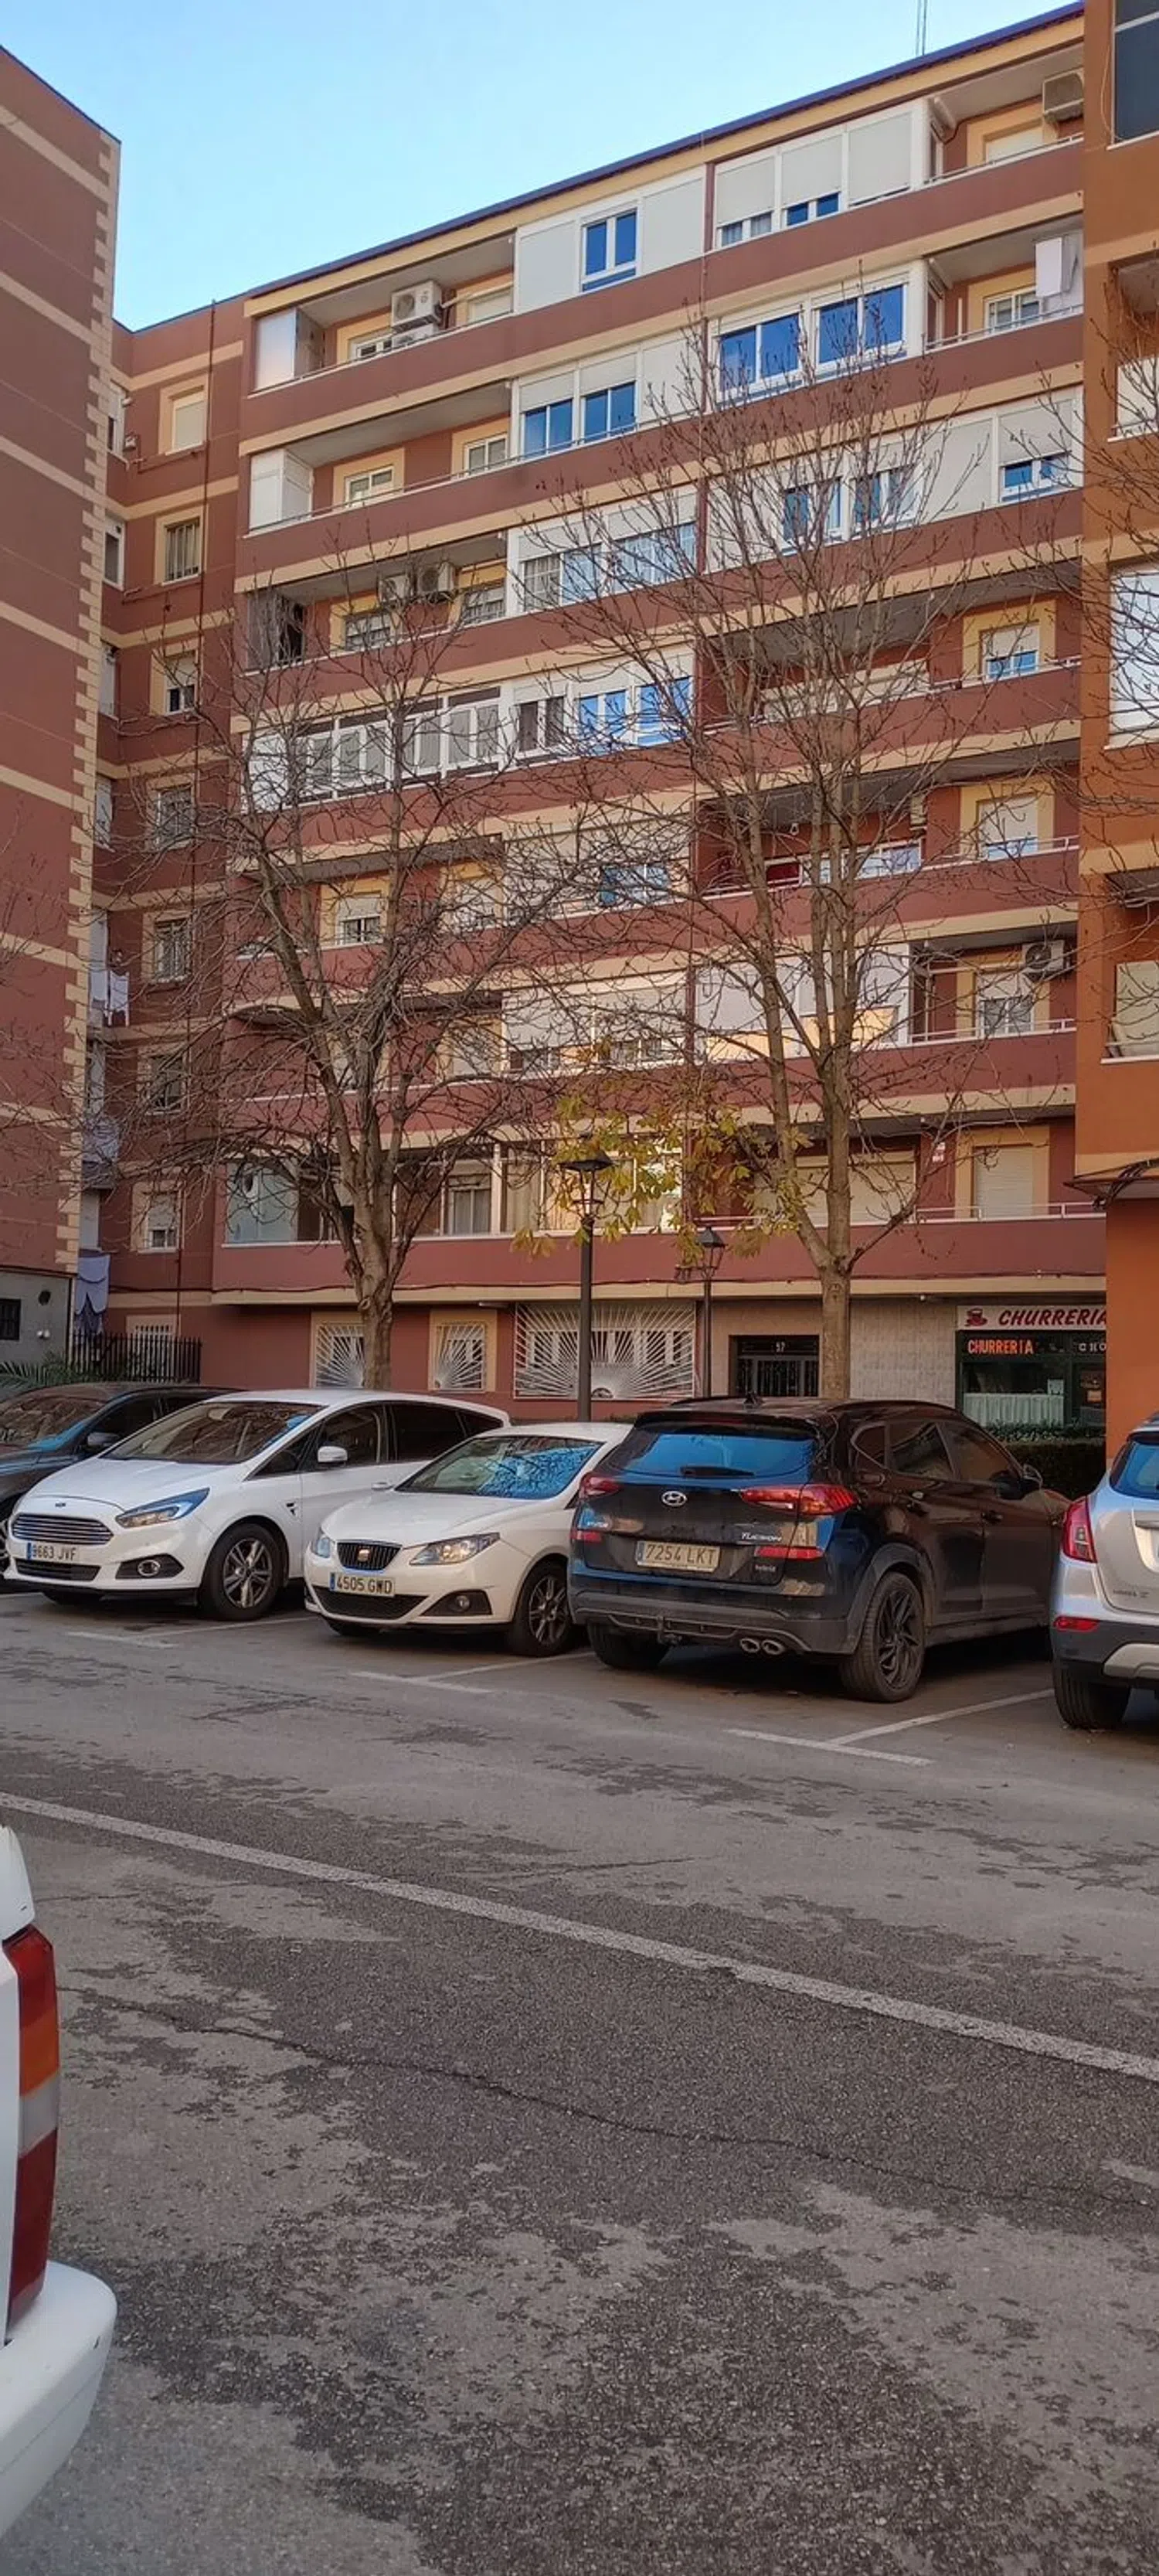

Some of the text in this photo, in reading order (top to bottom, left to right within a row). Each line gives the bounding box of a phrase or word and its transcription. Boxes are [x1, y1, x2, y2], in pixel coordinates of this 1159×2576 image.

[998, 1308, 1106, 1326] CHURRERIA
[967, 1339, 1035, 1354] CHURRERIA
[646, 1545, 716, 1565] 7254 LKT
[336, 1574, 393, 1594] 4505 GWD
